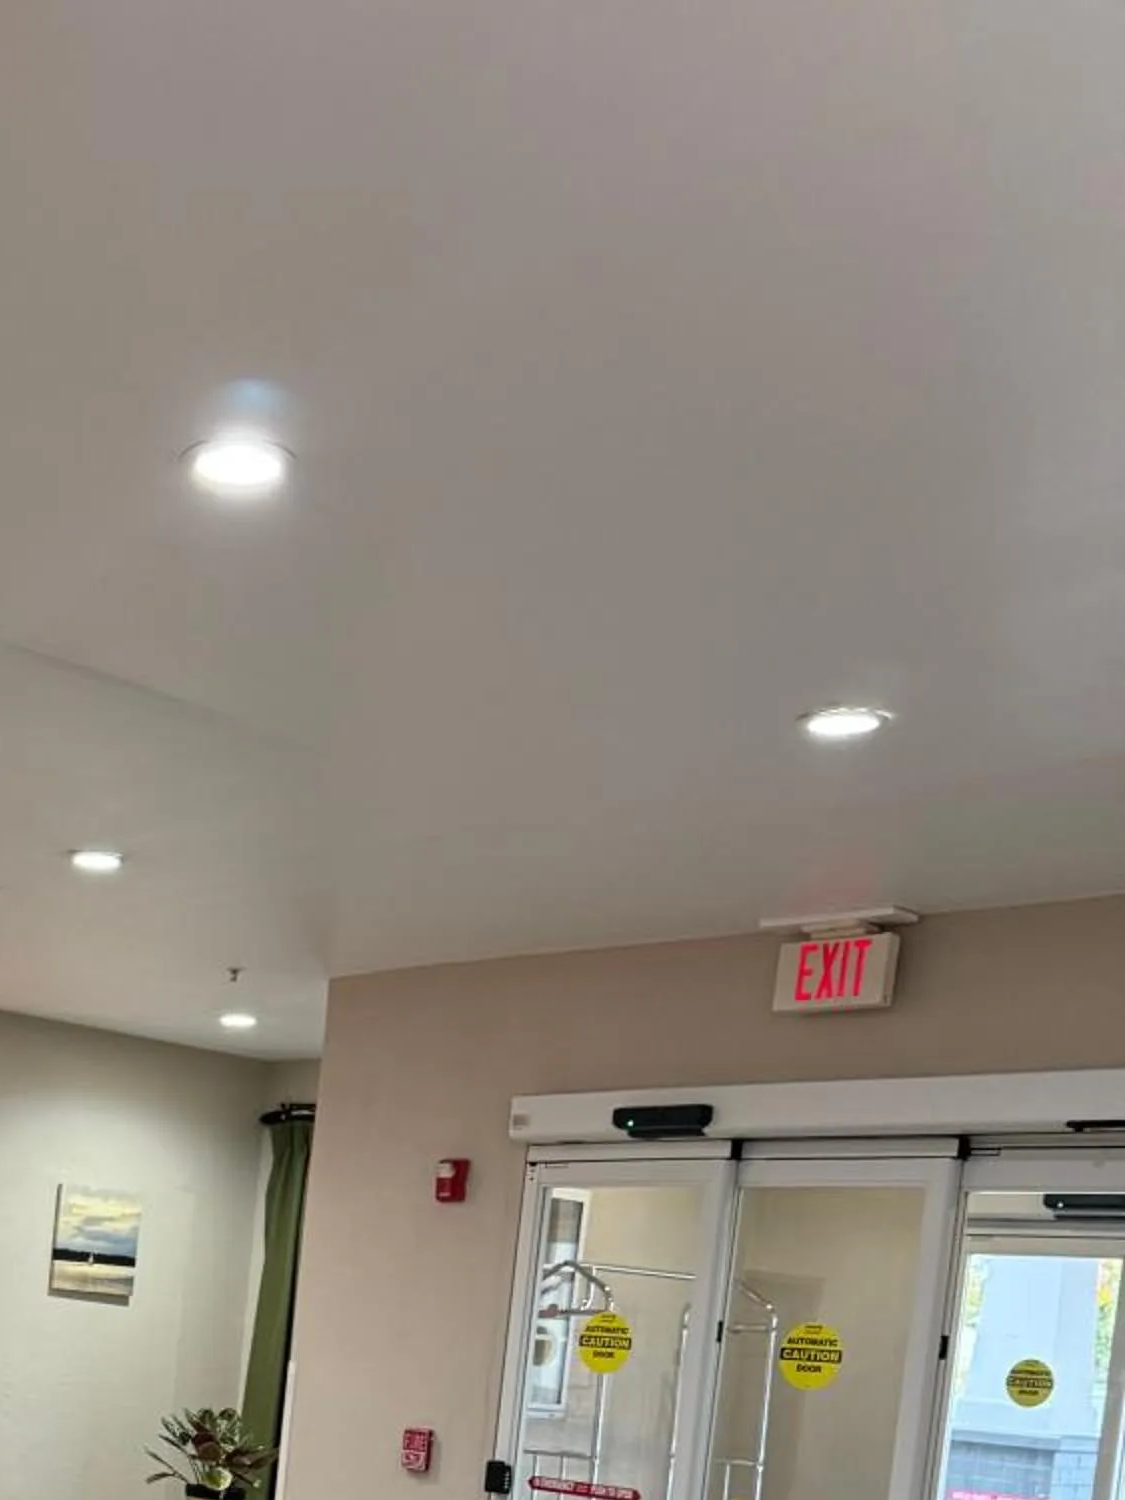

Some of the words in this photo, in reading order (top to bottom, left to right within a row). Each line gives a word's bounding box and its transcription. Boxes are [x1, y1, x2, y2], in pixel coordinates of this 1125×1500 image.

[794, 939, 872, 1001] EXIT
[582, 1337, 629, 1349] CAUTION
[787, 1337, 838, 1346] AUTOMATIC
[783, 1349, 840, 1361] CAUTION
[796, 1364, 822, 1373] DOOR
